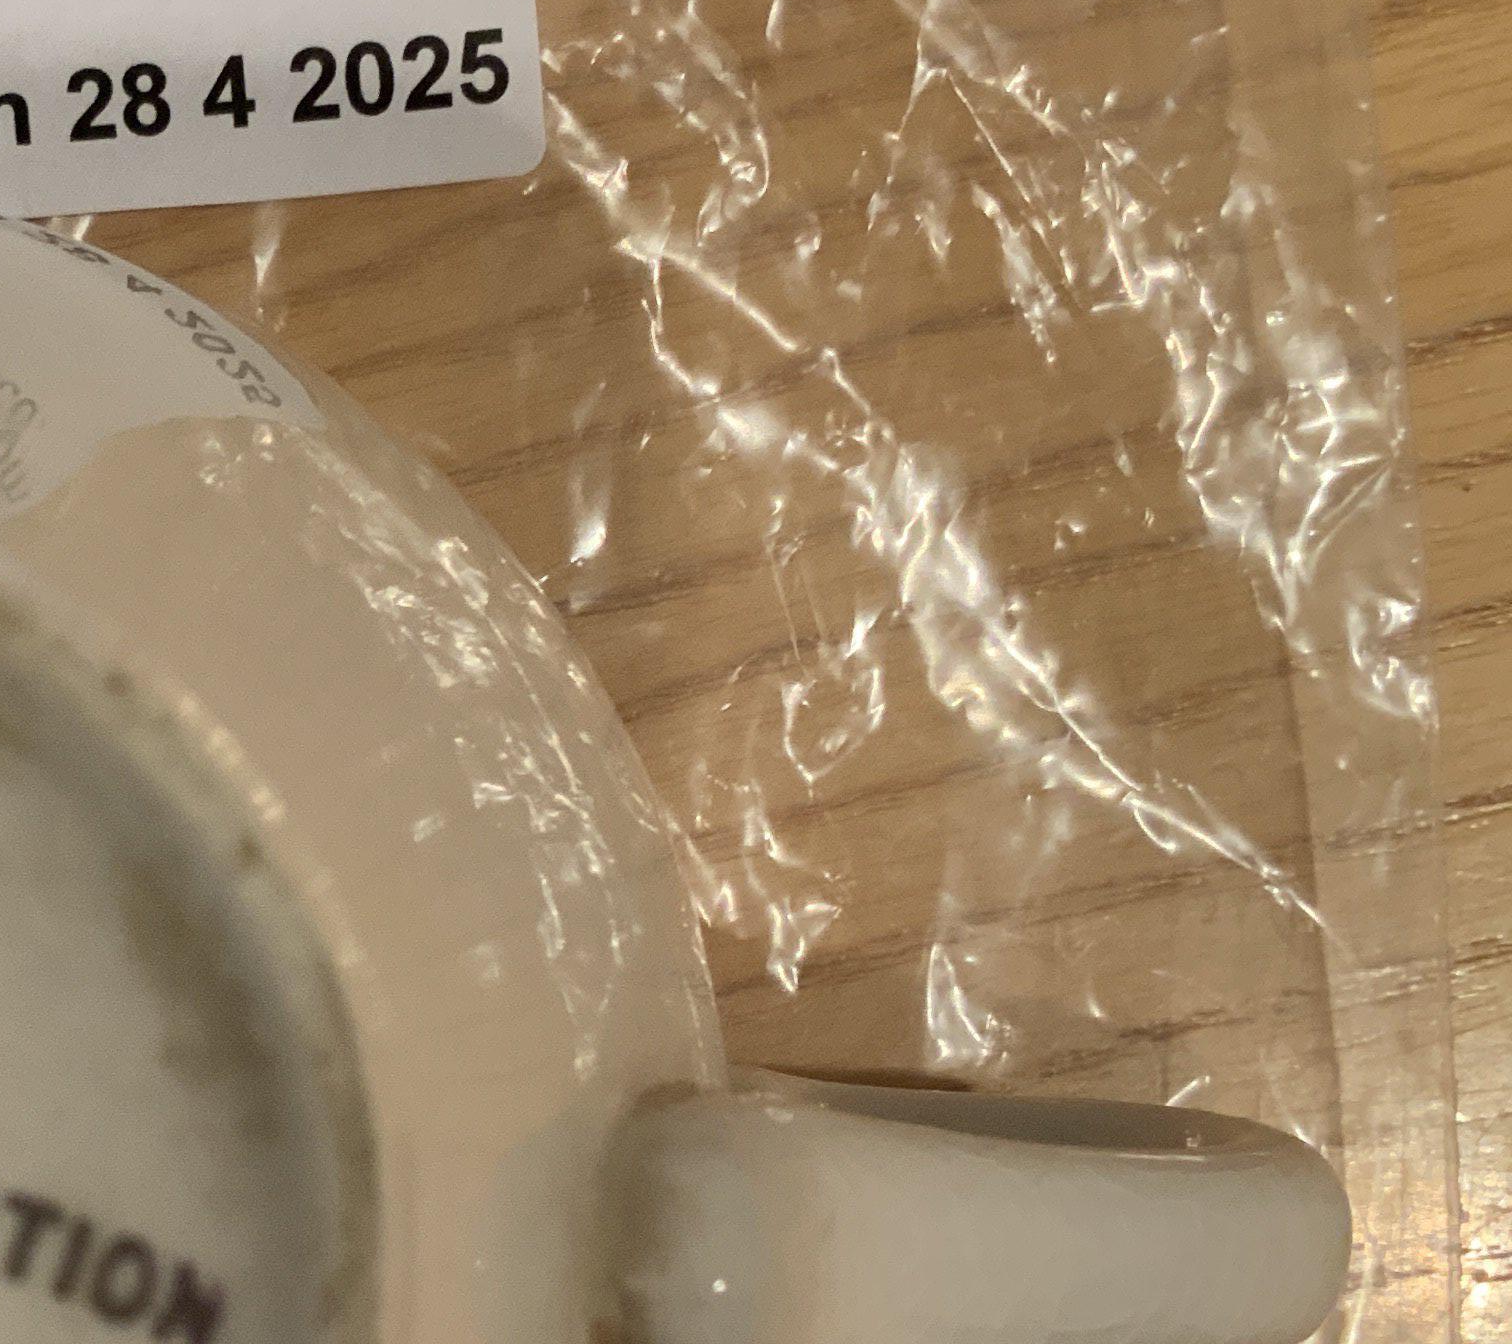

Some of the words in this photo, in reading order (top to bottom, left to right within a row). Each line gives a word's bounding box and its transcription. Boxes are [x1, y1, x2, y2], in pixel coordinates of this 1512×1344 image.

[65, 64, 173, 144] 28
[201, 55, 257, 129] 4
[288, 26, 512, 123] 2025
